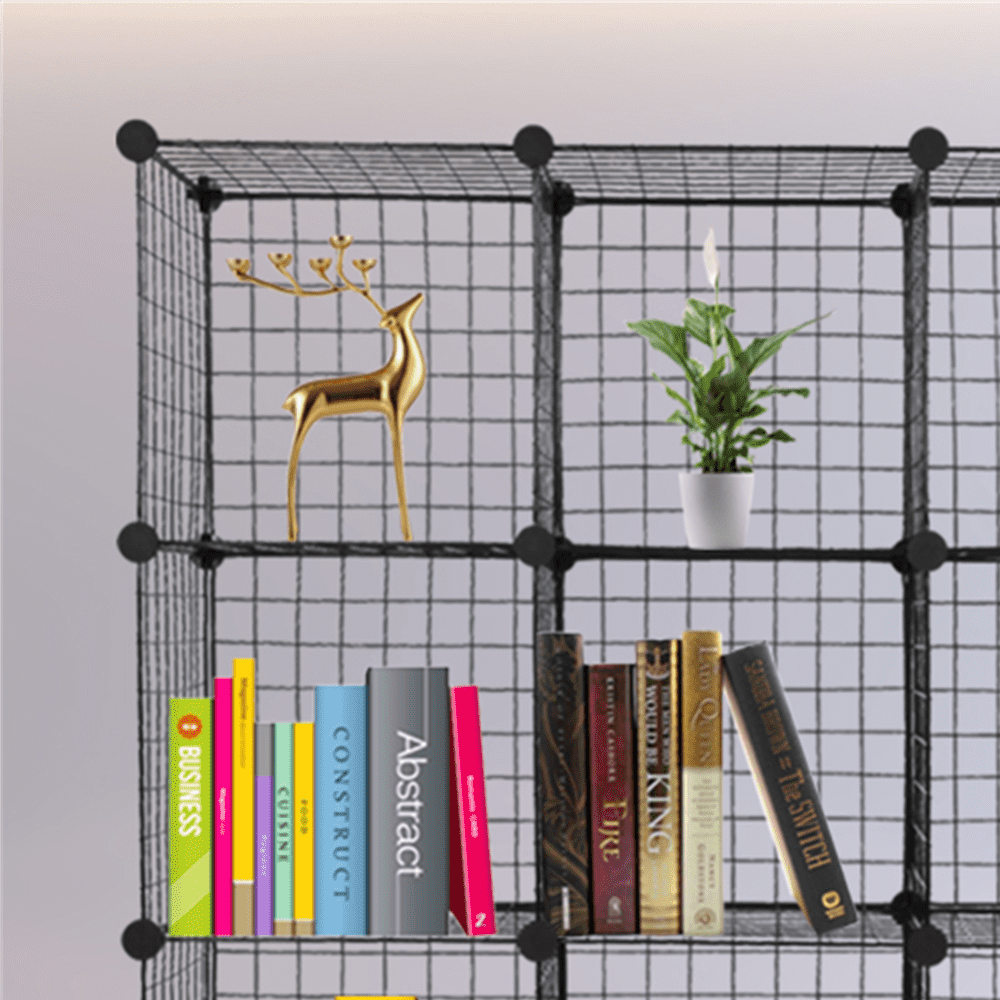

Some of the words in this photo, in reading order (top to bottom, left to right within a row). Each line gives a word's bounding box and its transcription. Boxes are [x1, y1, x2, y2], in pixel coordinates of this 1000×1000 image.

[646, 685, 658, 744] WOULD
[178, 745, 202, 837] BUSINESS
[646, 747, 658, 767] BE
[778, 768, 805, 803] The
[278, 786, 289, 863] CUISINE
[332, 725, 351, 901] CONSTRUCT
[395, 730, 428, 878] Abstract
[598, 799, 627, 863] FIRE
[646, 772, 673, 855] KING
[788, 799, 832, 871] SWITCH
